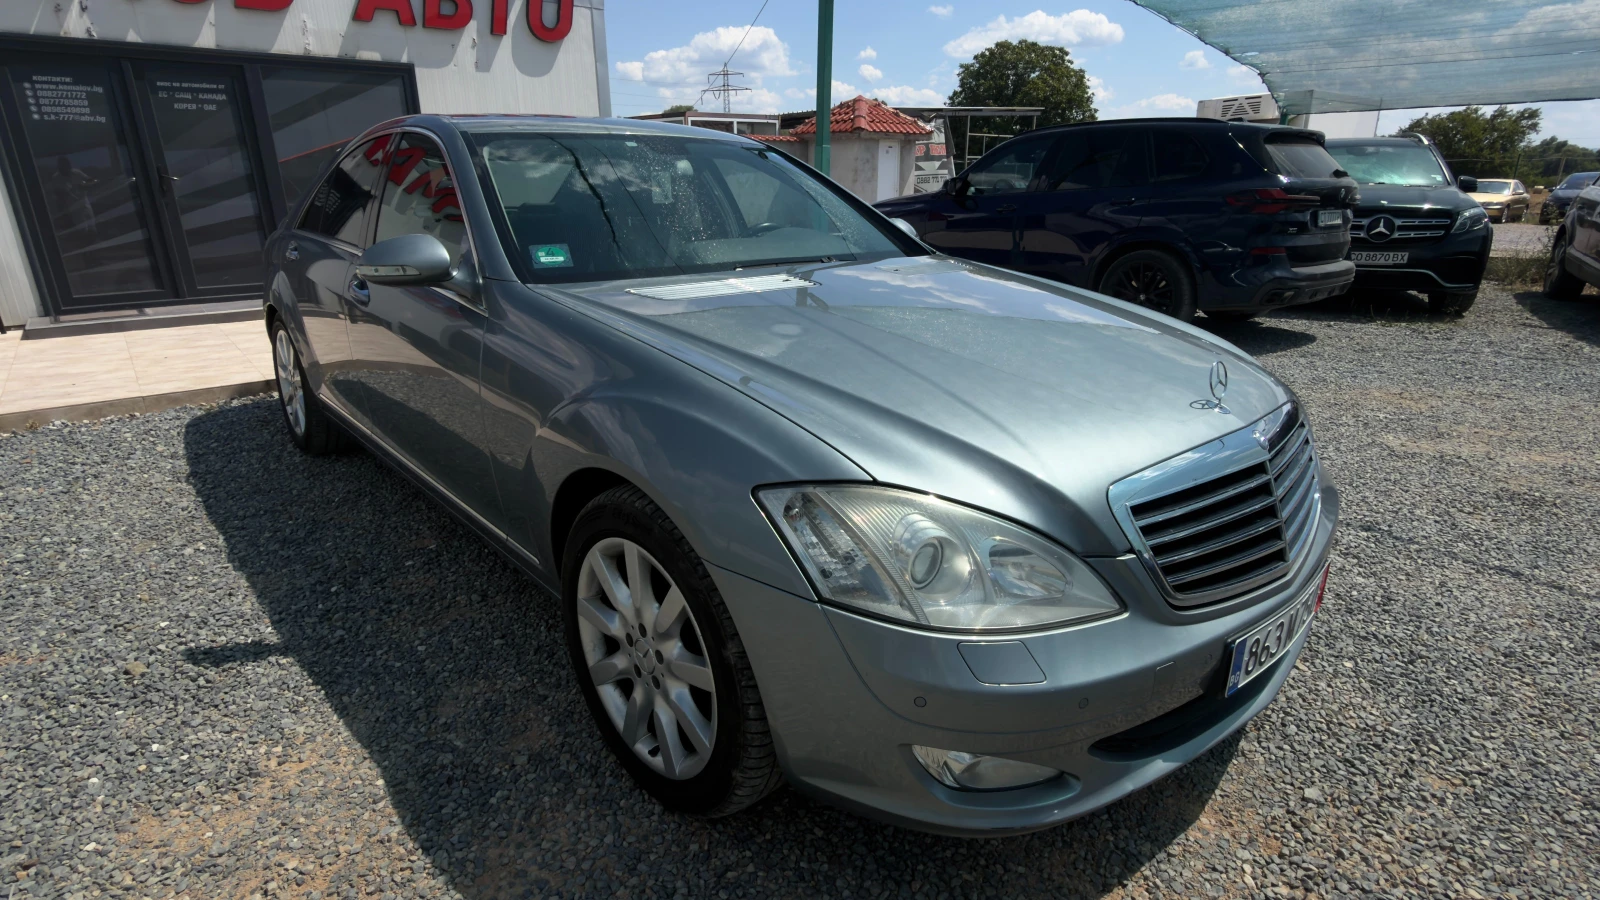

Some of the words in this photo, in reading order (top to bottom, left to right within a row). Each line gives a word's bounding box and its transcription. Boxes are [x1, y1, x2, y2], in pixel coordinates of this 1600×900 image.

[34, 83, 103, 93] www.kemalov.bg
[36, 90, 87, 99] 0882771772
[174, 91, 192, 99] САЩ
[198, 92, 227, 100] КАНАДА
[546, 247, 556, 257] 4
[1365, 253, 1391, 262] 8870
[1391, 253, 1407, 263] BX
[1244, 620, 1285, 676] 863
[1229, 671, 1240, 687] BG
